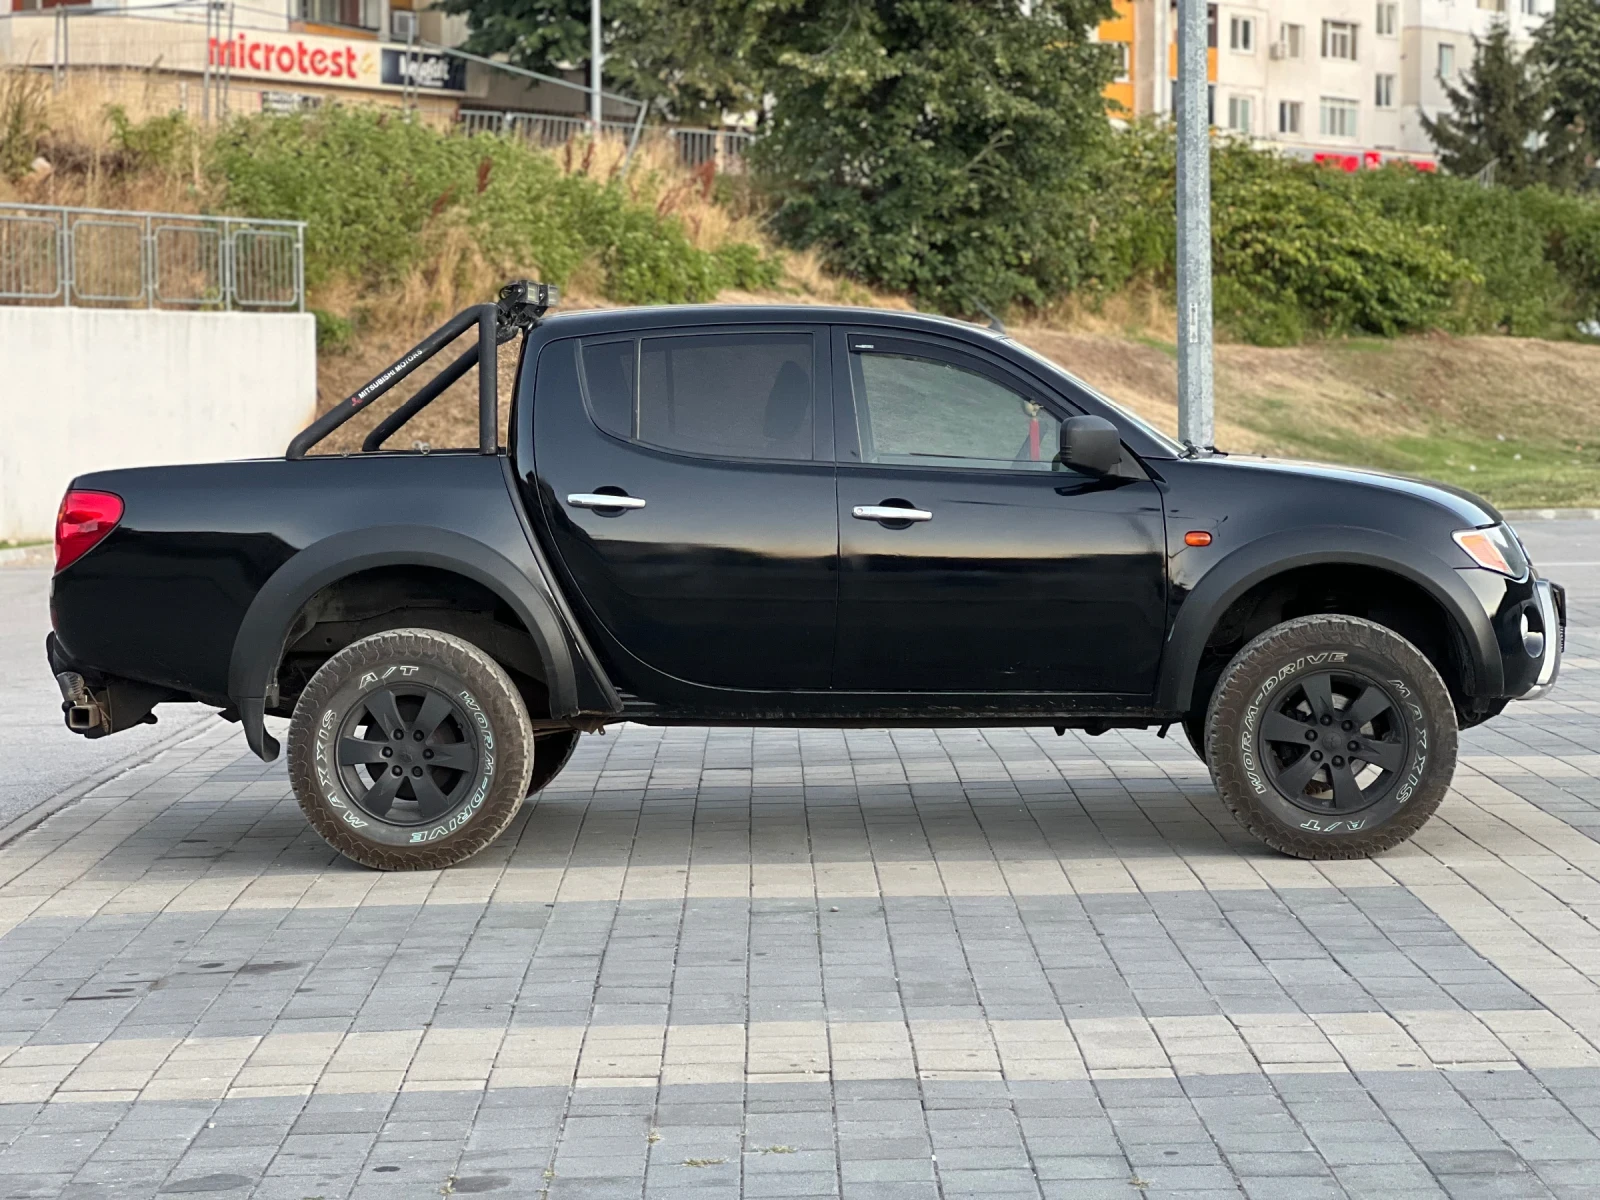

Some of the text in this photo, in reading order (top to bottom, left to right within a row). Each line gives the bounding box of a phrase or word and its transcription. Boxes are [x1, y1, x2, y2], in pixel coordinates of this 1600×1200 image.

[208, 33, 357, 79] microtest
[358, 349, 423, 399] MITSUBISHI MOTORS
[358, 665, 419, 690] A/T
[1241, 652, 1348, 795] WORM-DRIVE
[1387, 679, 1427, 803] MAXXIS
[316, 709, 369, 829] MAXXIS
[409, 690, 495, 843] WORM-DRIVE
[1300, 817, 1368, 832] A/T
